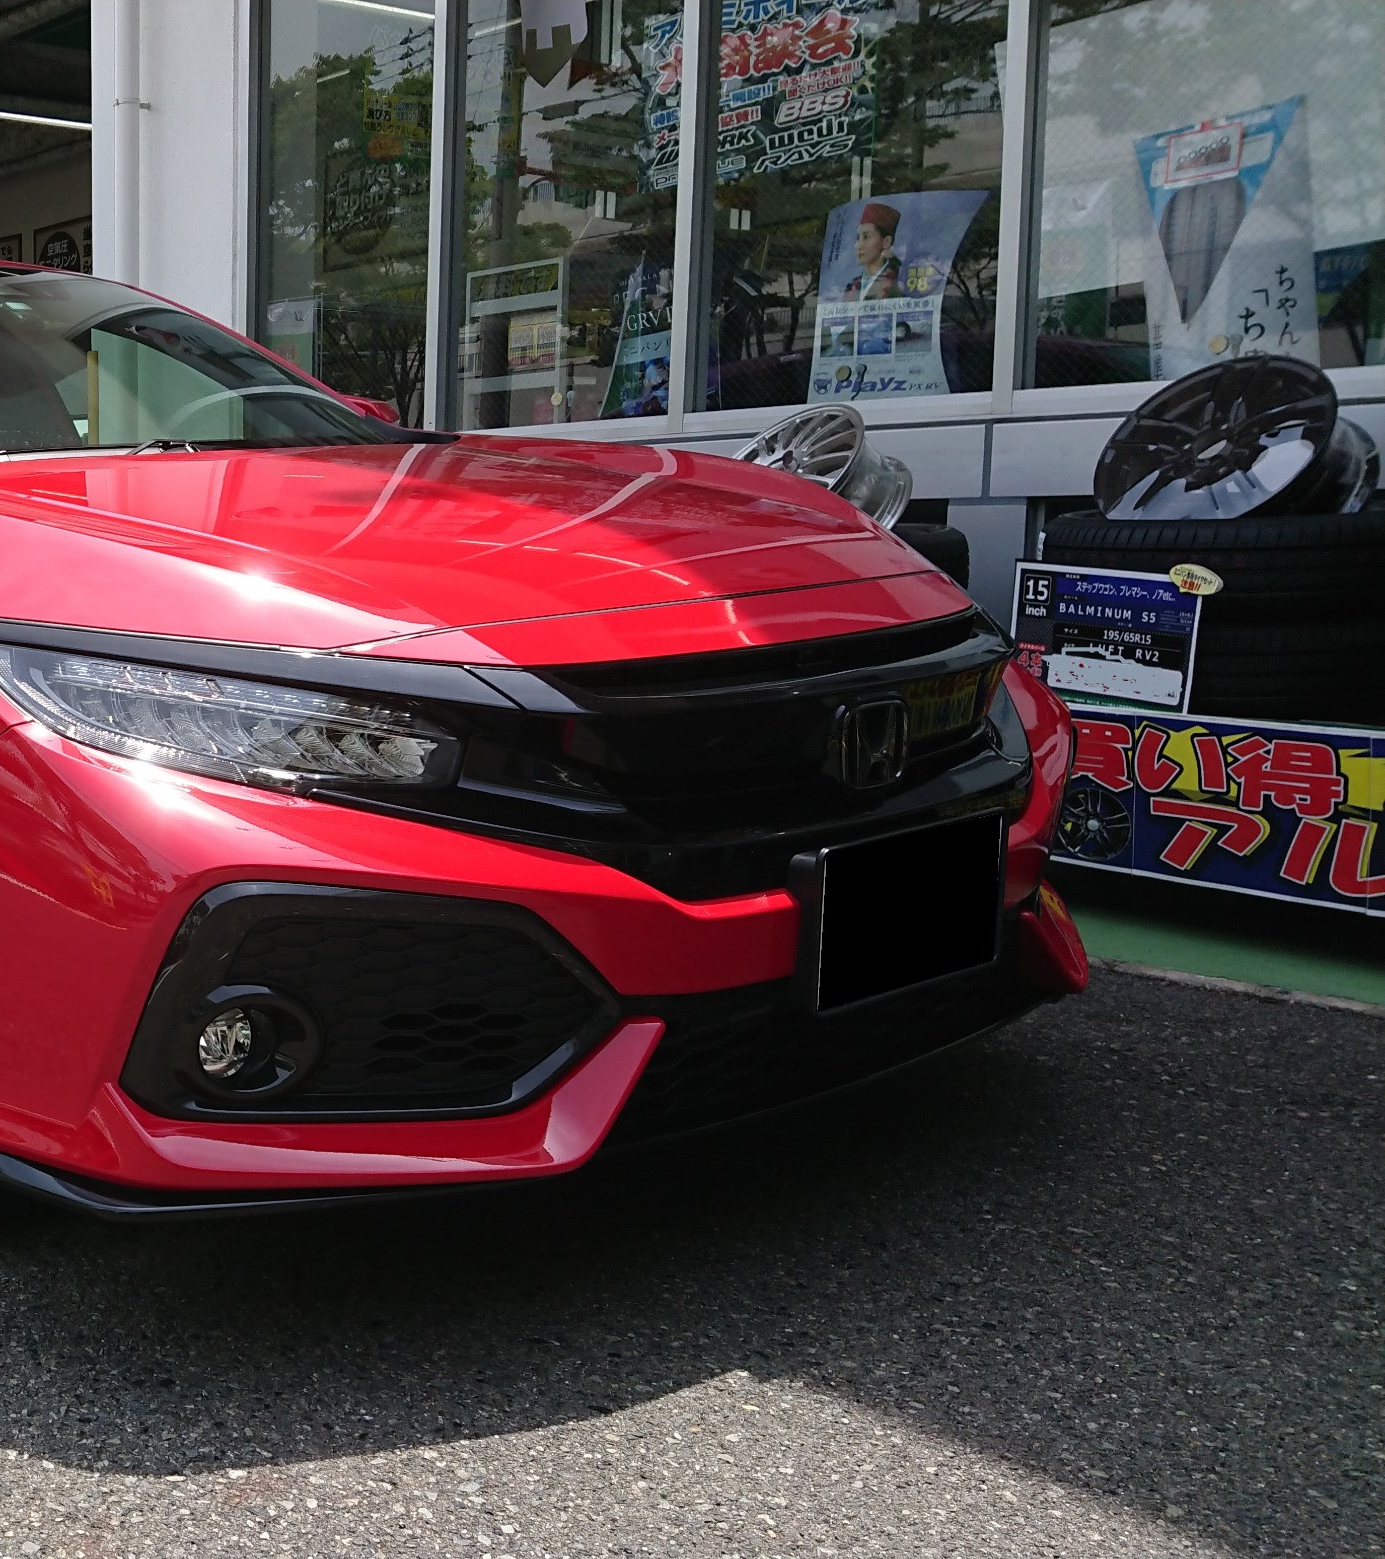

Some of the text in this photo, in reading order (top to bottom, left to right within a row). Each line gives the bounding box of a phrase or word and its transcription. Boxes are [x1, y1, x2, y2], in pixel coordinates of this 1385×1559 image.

[776, 88, 851, 126] BBS
[753, 135, 856, 174] RAYS
[1025, 578, 1050, 601] 15
[1025, 604, 1047, 617] inch
[1059, 602, 1133, 621] BALMINUM
[1141, 611, 1158, 624] S5
[1103, 629, 1153, 646] 195/65R15
[1017, 650, 1044, 667] 4本
[1135, 648, 1160, 663] RV2
[1159, 796, 1385, 898] アル
